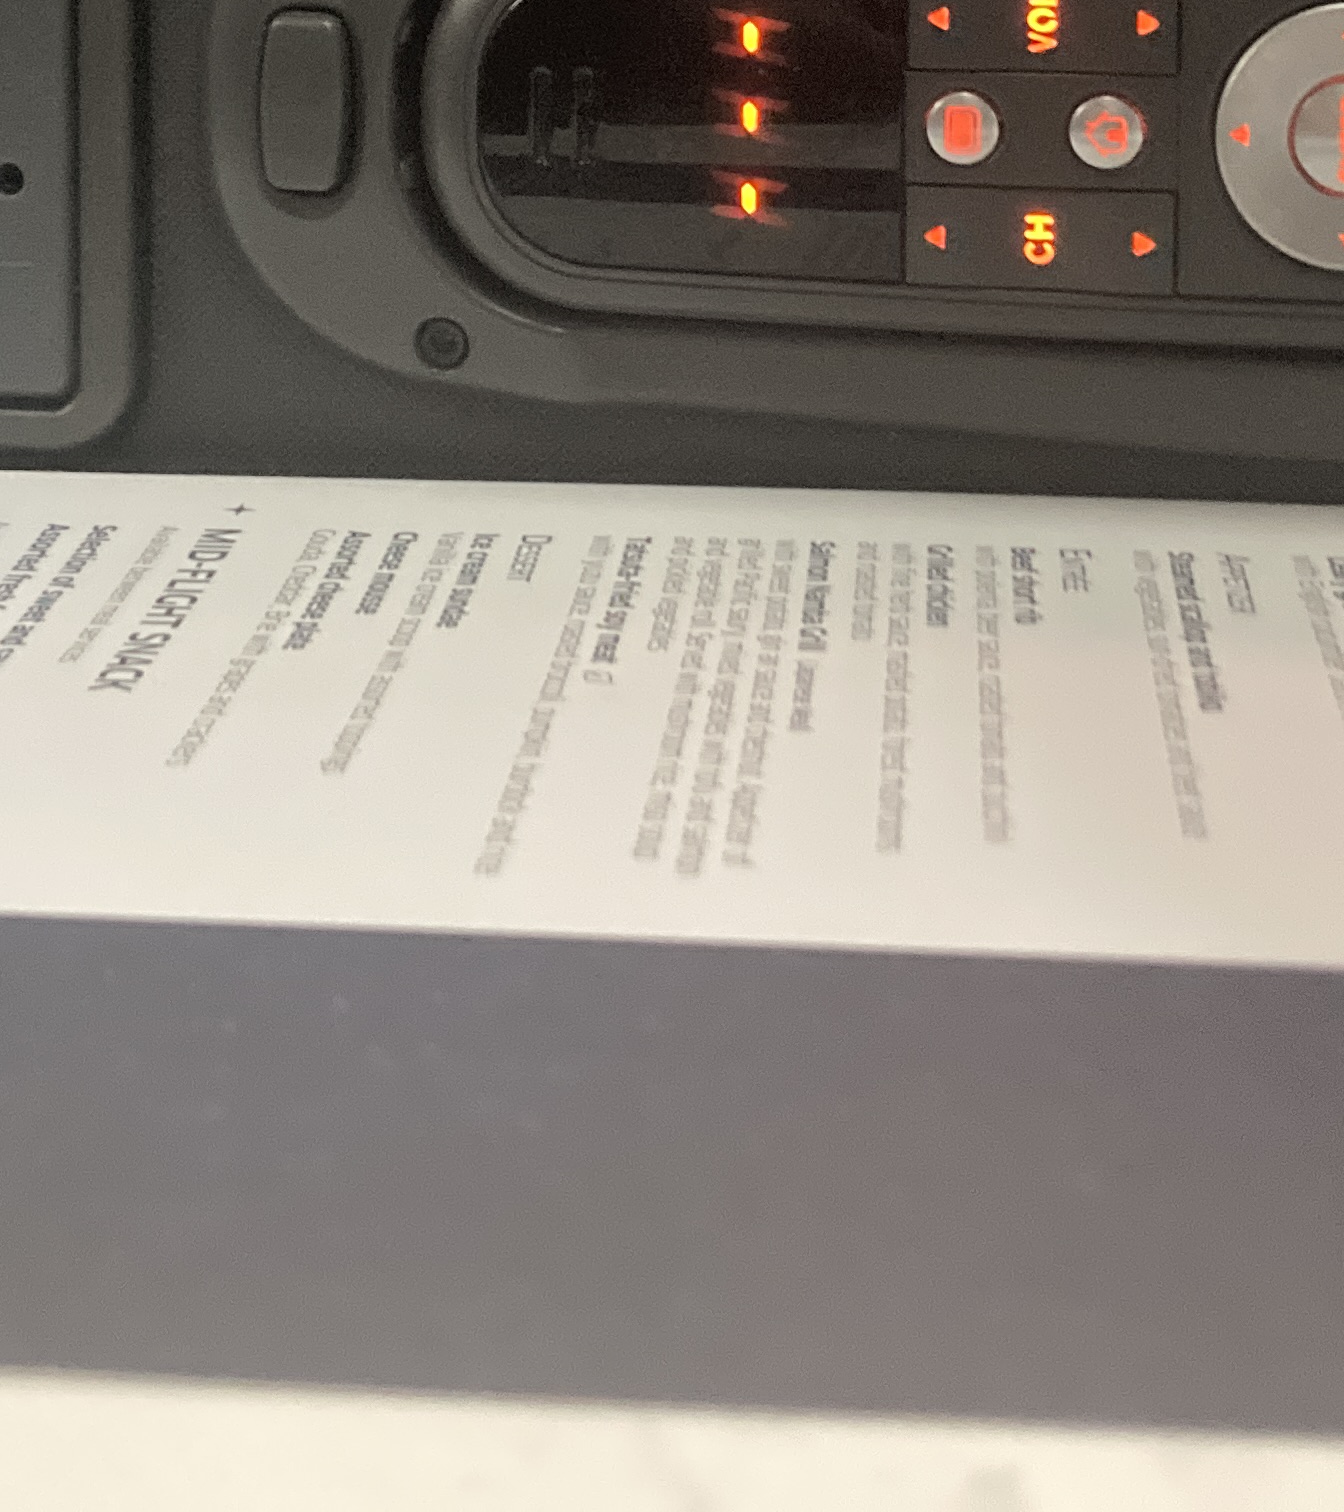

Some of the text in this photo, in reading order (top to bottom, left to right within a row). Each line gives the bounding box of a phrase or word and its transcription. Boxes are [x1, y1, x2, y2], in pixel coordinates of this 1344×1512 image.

[1024, 212, 1055, 265] CH
[11, 523, 70, 572] Assorted
[60, 524, 118, 574] Selection
[354, 531, 419, 615] Cheese mousse
[49, 576, 76, 589] of
[281, 530, 371, 651] Assorted cheese plate
[435, 533, 500, 629] Ice cream sundae
[590, 536, 653, 664] Tatsuta-fried soy meat
[797, 540, 836, 651] Salmon Namba Grill
[926, 544, 954, 628] Grilled chicken
[1010, 547, 1041, 626] Beef short rib
[1167, 551, 1200, 600] Steamed
[19, 589, 64, 622] sweet
[89, 528, 241, 692] MID-FLIGHT SNACK
[255, 610, 289, 632] Brie
[0, 624, 35, 646] and
[242, 634, 271, 656] with
[199, 695, 232, 717] and
